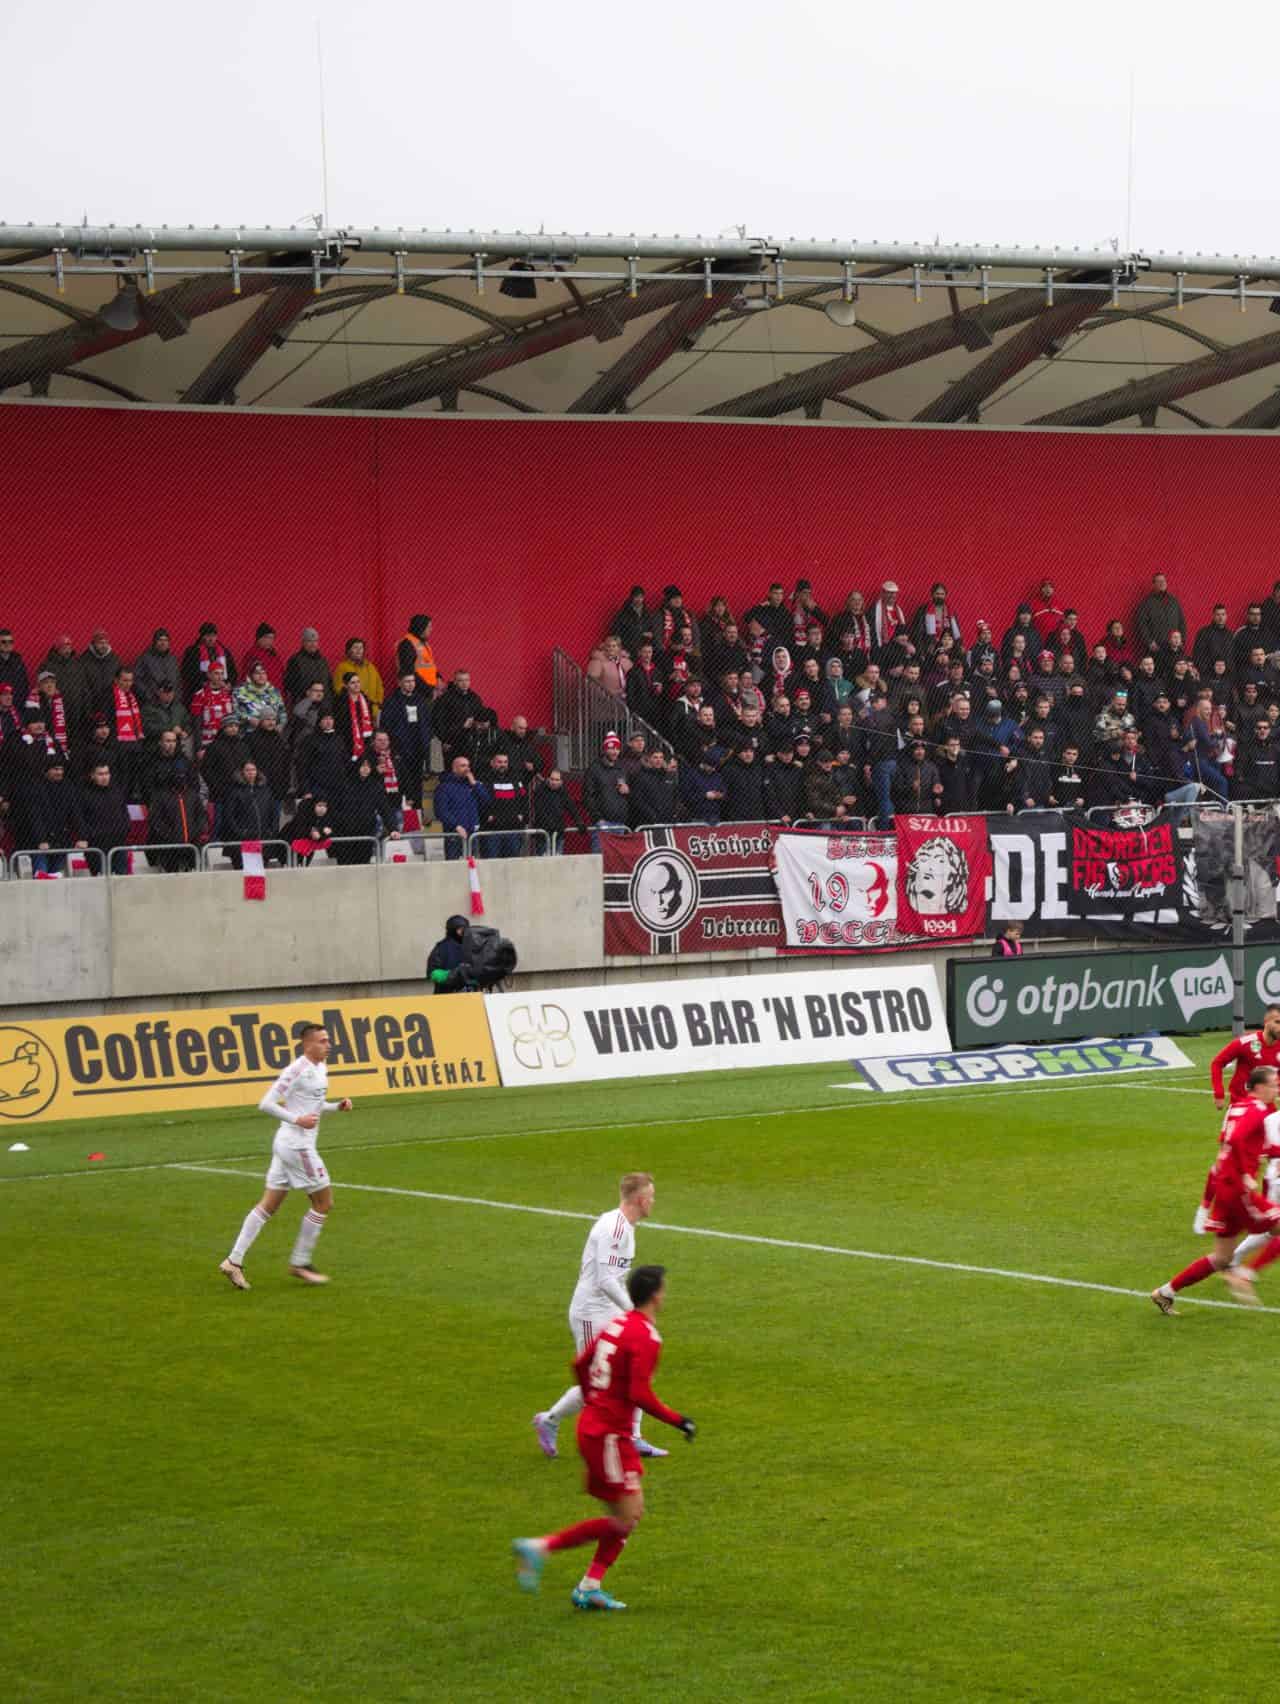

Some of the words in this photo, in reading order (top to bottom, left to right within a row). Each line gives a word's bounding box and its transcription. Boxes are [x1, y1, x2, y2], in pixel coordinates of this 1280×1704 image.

[923, 919, 957, 934] 1994
[1017, 966, 1169, 1026] otpbank
[1183, 975, 1227, 998] LIGA
[584, 1003, 679, 1055] VINO
[682, 999, 761, 1047] BAR
[764, 997, 802, 1042] 'N
[805, 987, 933, 1038] BISTRO
[385, 1059, 486, 1089] KÁVÉHÁZ
